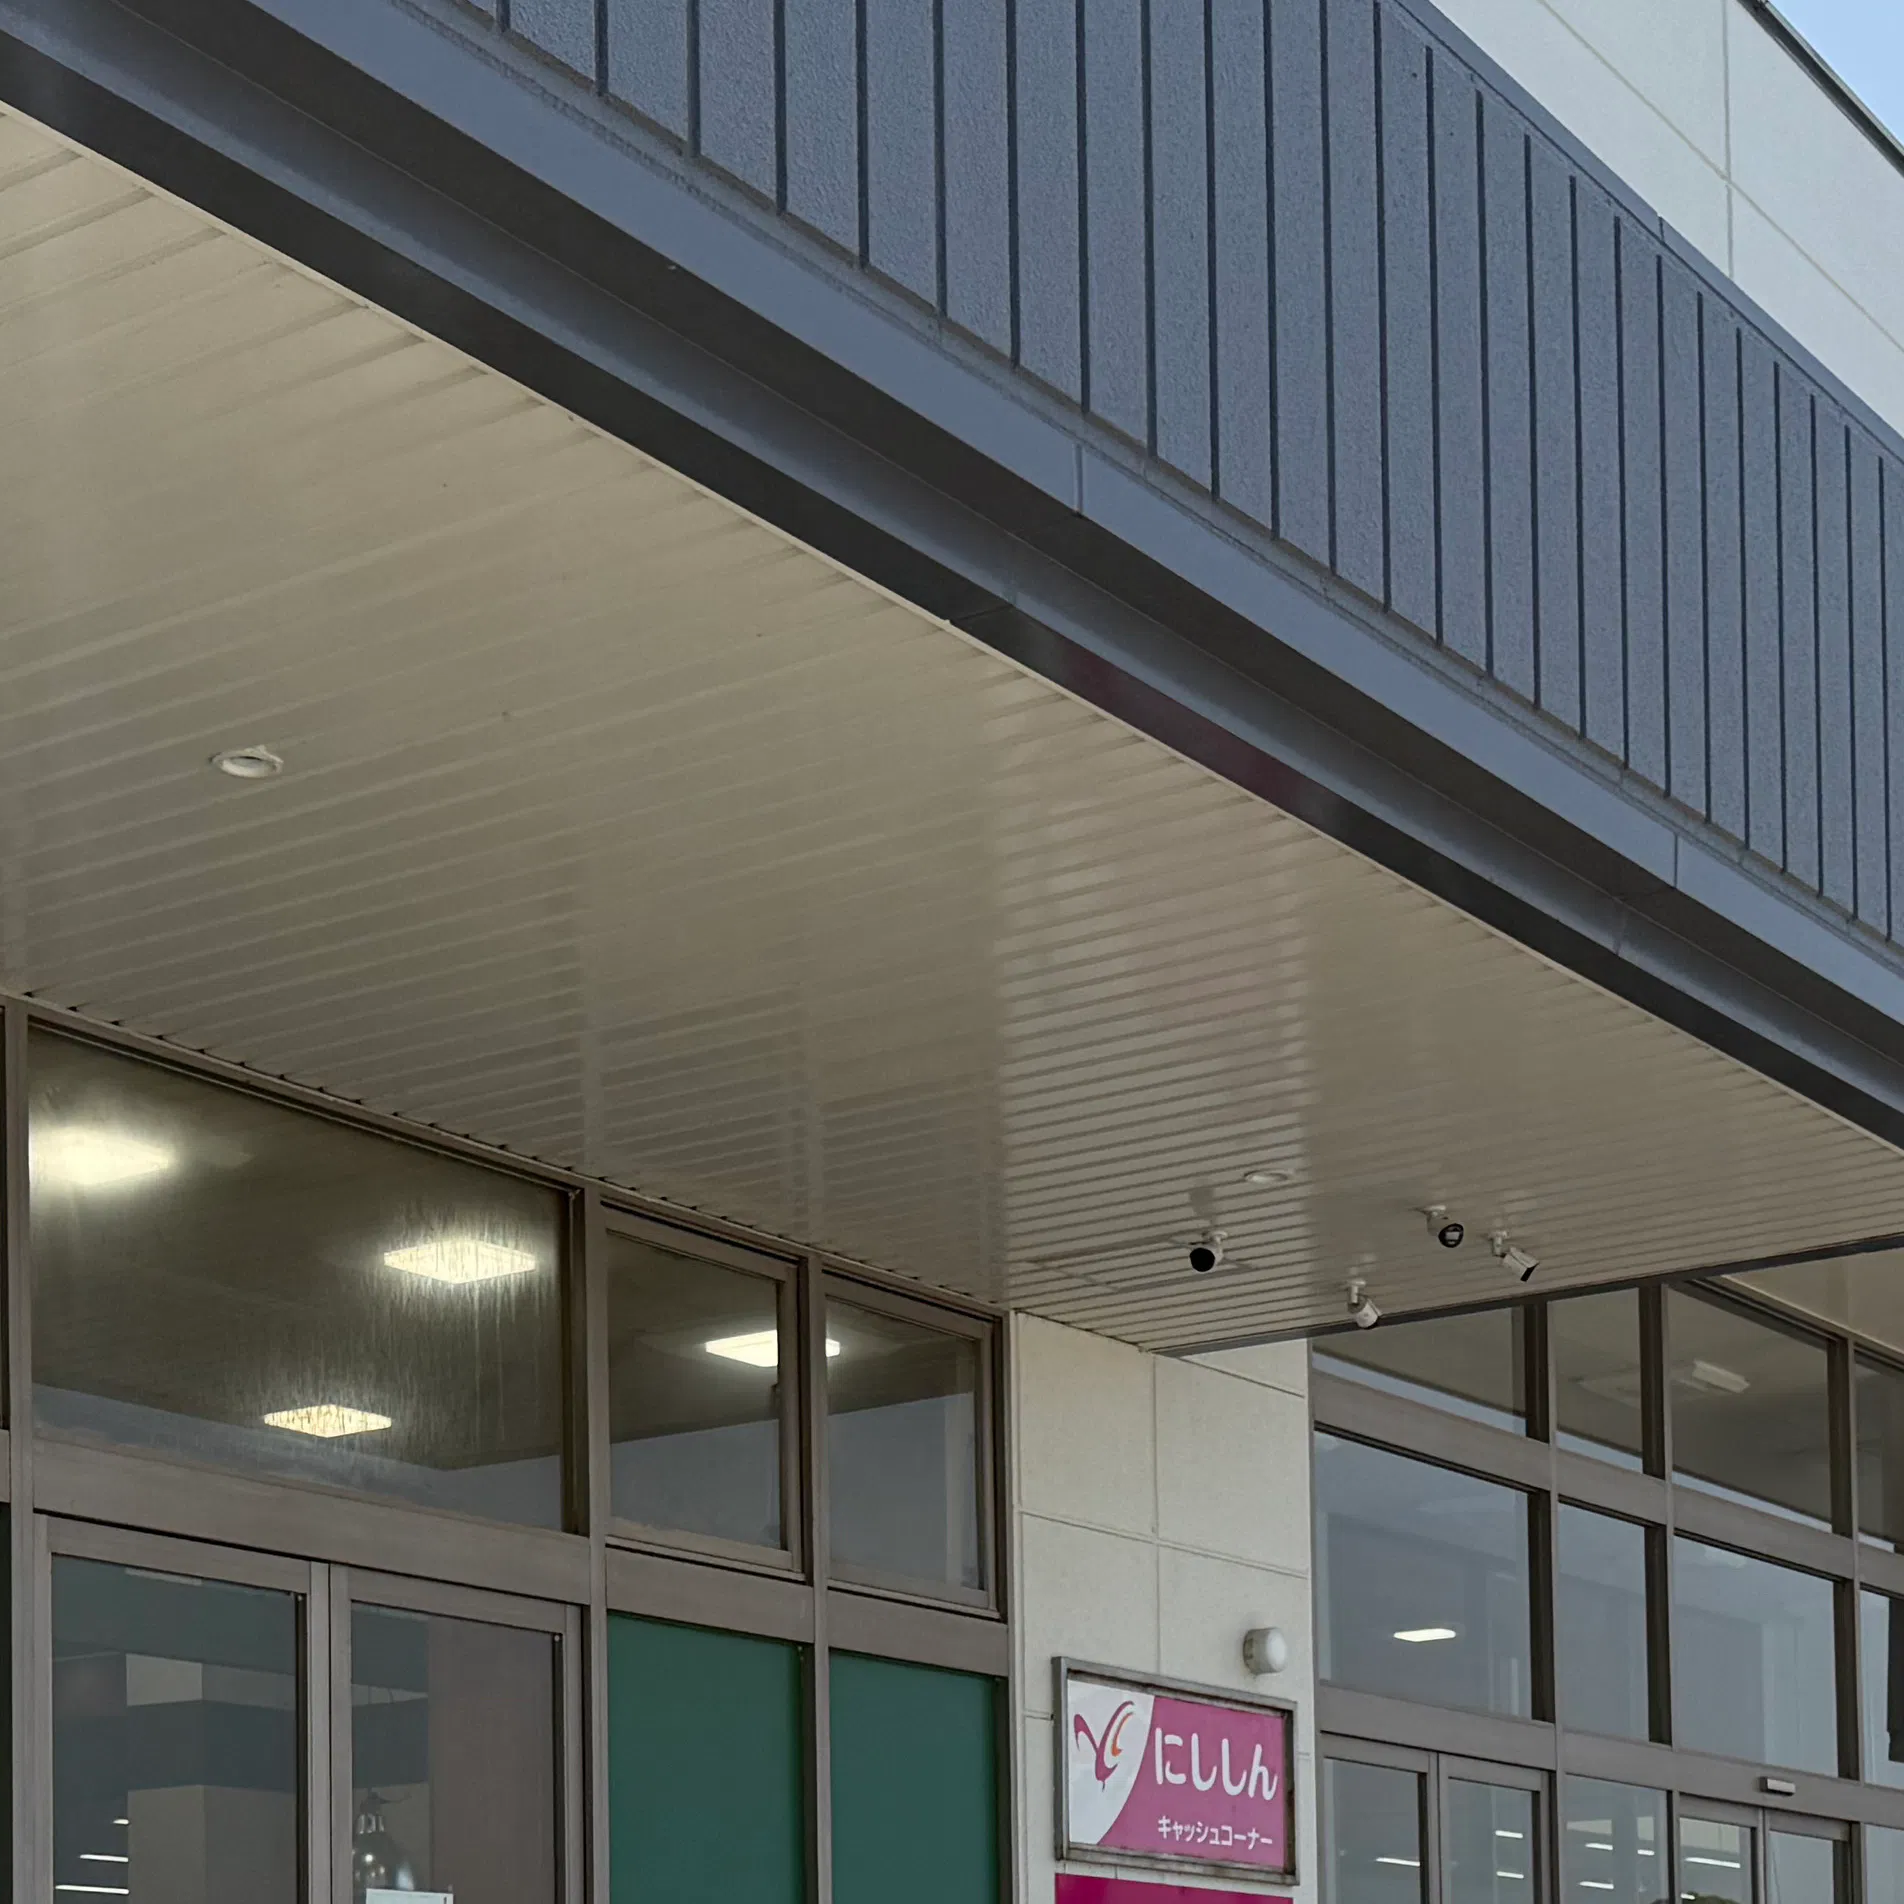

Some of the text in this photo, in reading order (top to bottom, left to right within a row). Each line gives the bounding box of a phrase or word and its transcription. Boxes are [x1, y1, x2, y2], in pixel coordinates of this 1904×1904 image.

[1154, 1727, 1278, 1801] にししん
[1157, 1815, 1273, 1850] キャッシュコーナー
